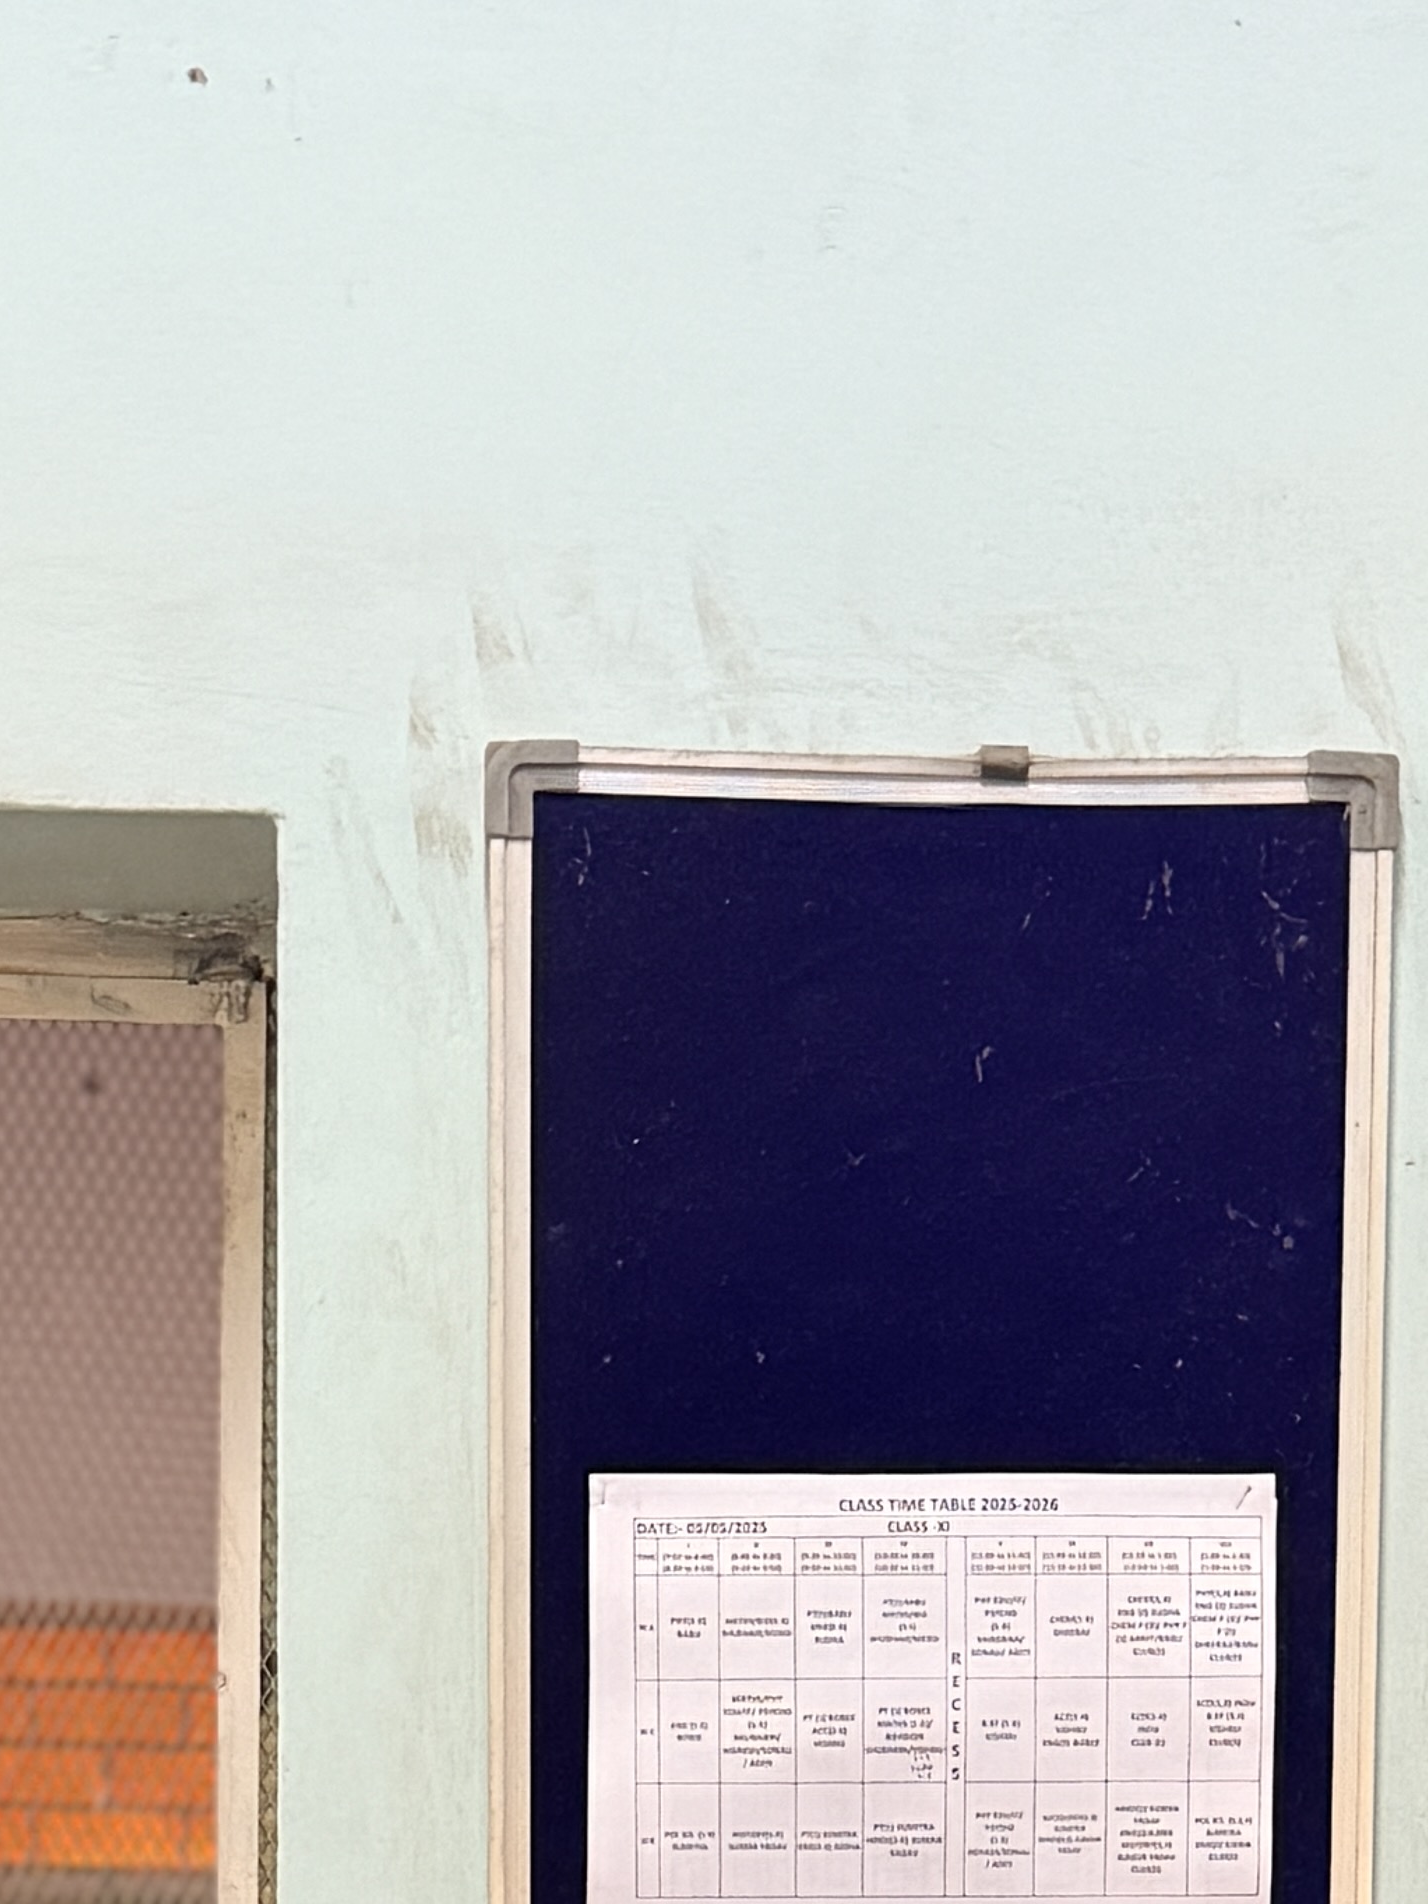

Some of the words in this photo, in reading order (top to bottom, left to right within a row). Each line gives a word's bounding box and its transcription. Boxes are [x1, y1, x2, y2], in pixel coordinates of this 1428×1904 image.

[839, 1498, 884, 1512] CLASS
[888, 1498, 926, 1512] TIME
[930, 1497, 976, 1511] TABLE
[887, 1520, 929, 1533] CLASS
